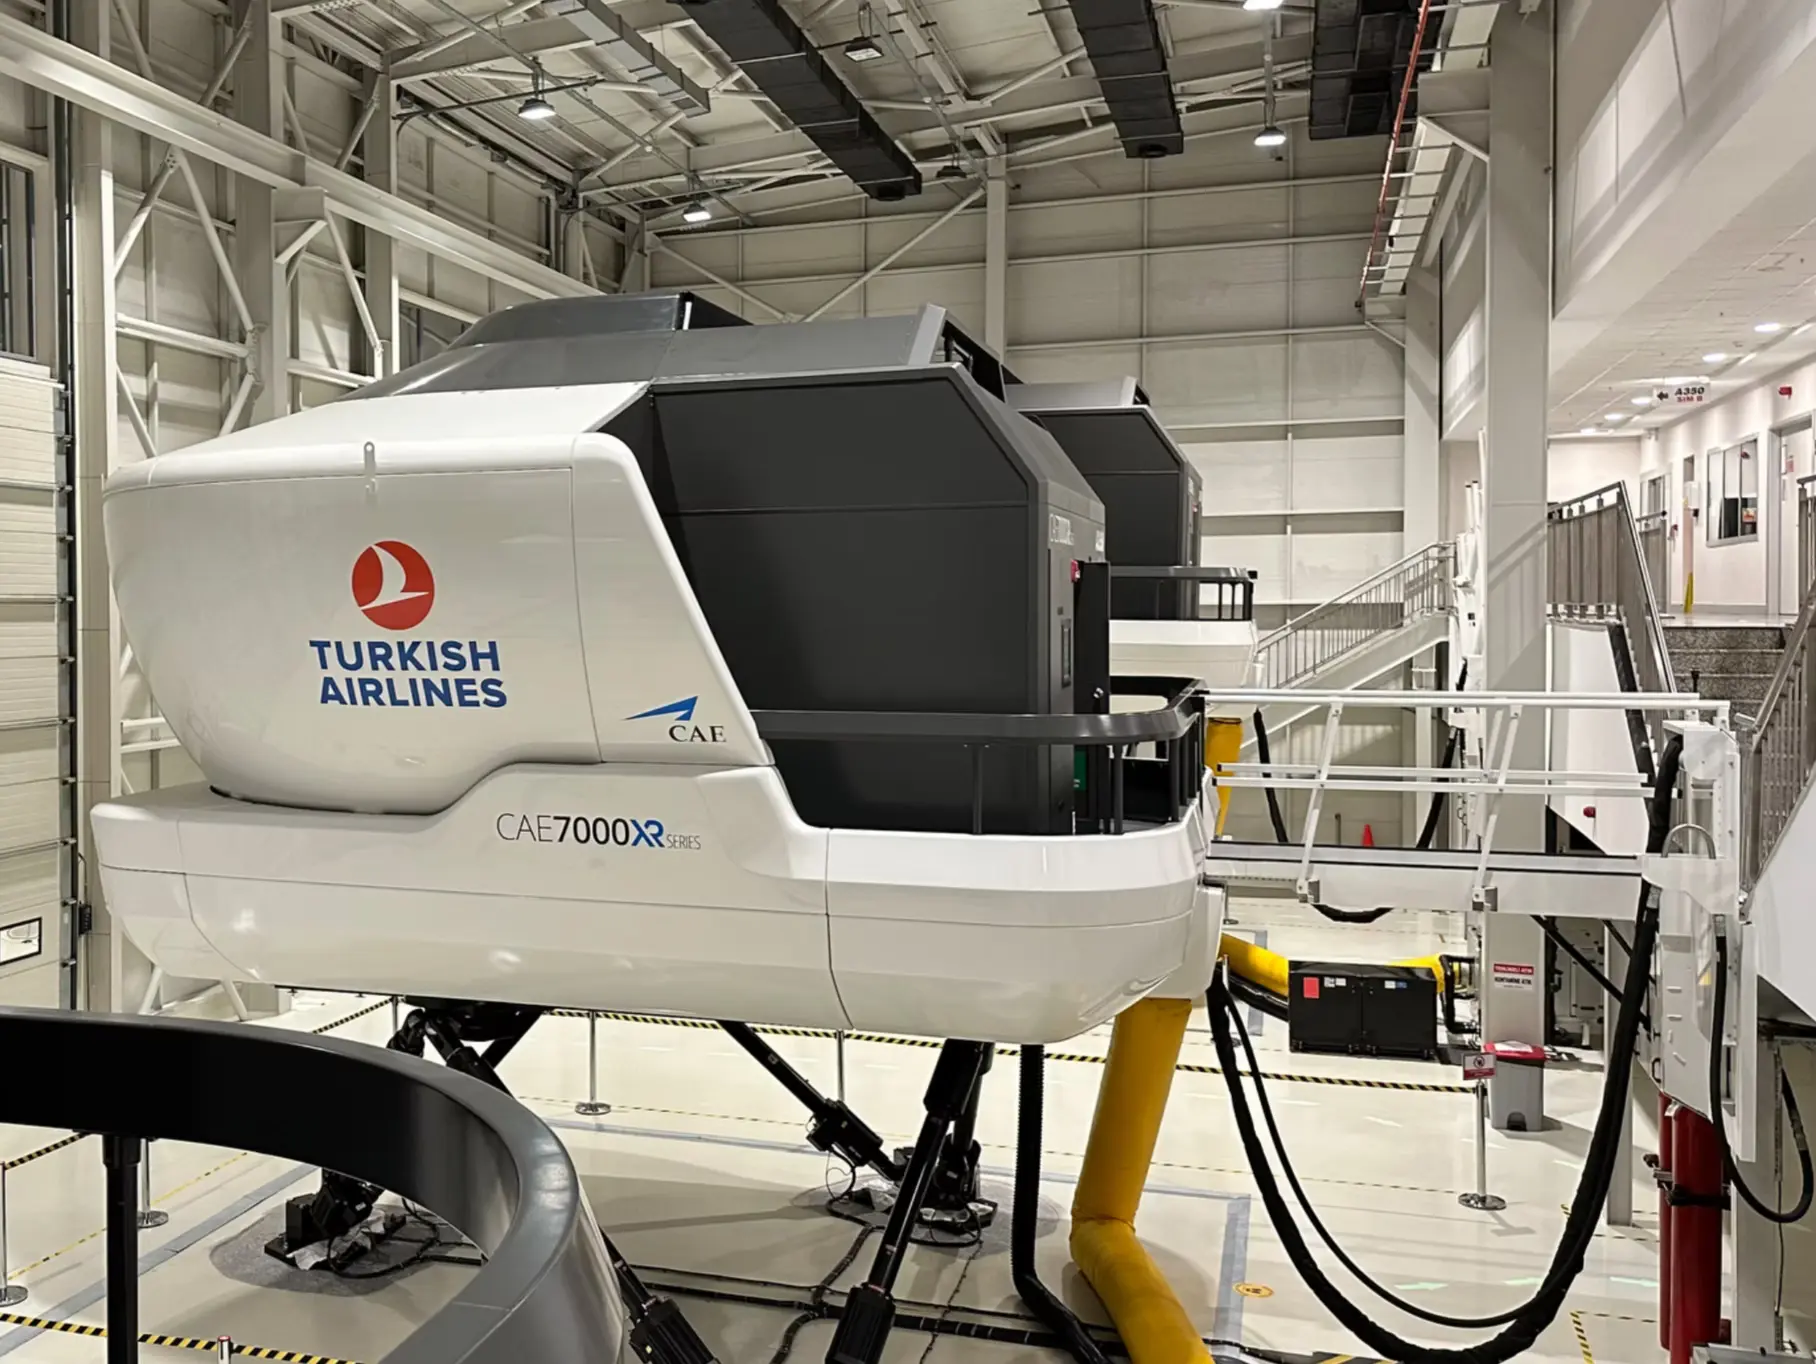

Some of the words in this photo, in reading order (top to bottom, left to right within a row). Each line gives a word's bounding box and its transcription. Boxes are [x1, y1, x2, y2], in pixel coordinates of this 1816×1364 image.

[1674, 386, 1705, 396] A350
[309, 640, 501, 672] TURKISH
[320, 676, 508, 708] AIRLINES
[668, 724, 727, 743] CAE
[666, 833, 702, 850] SERIES
